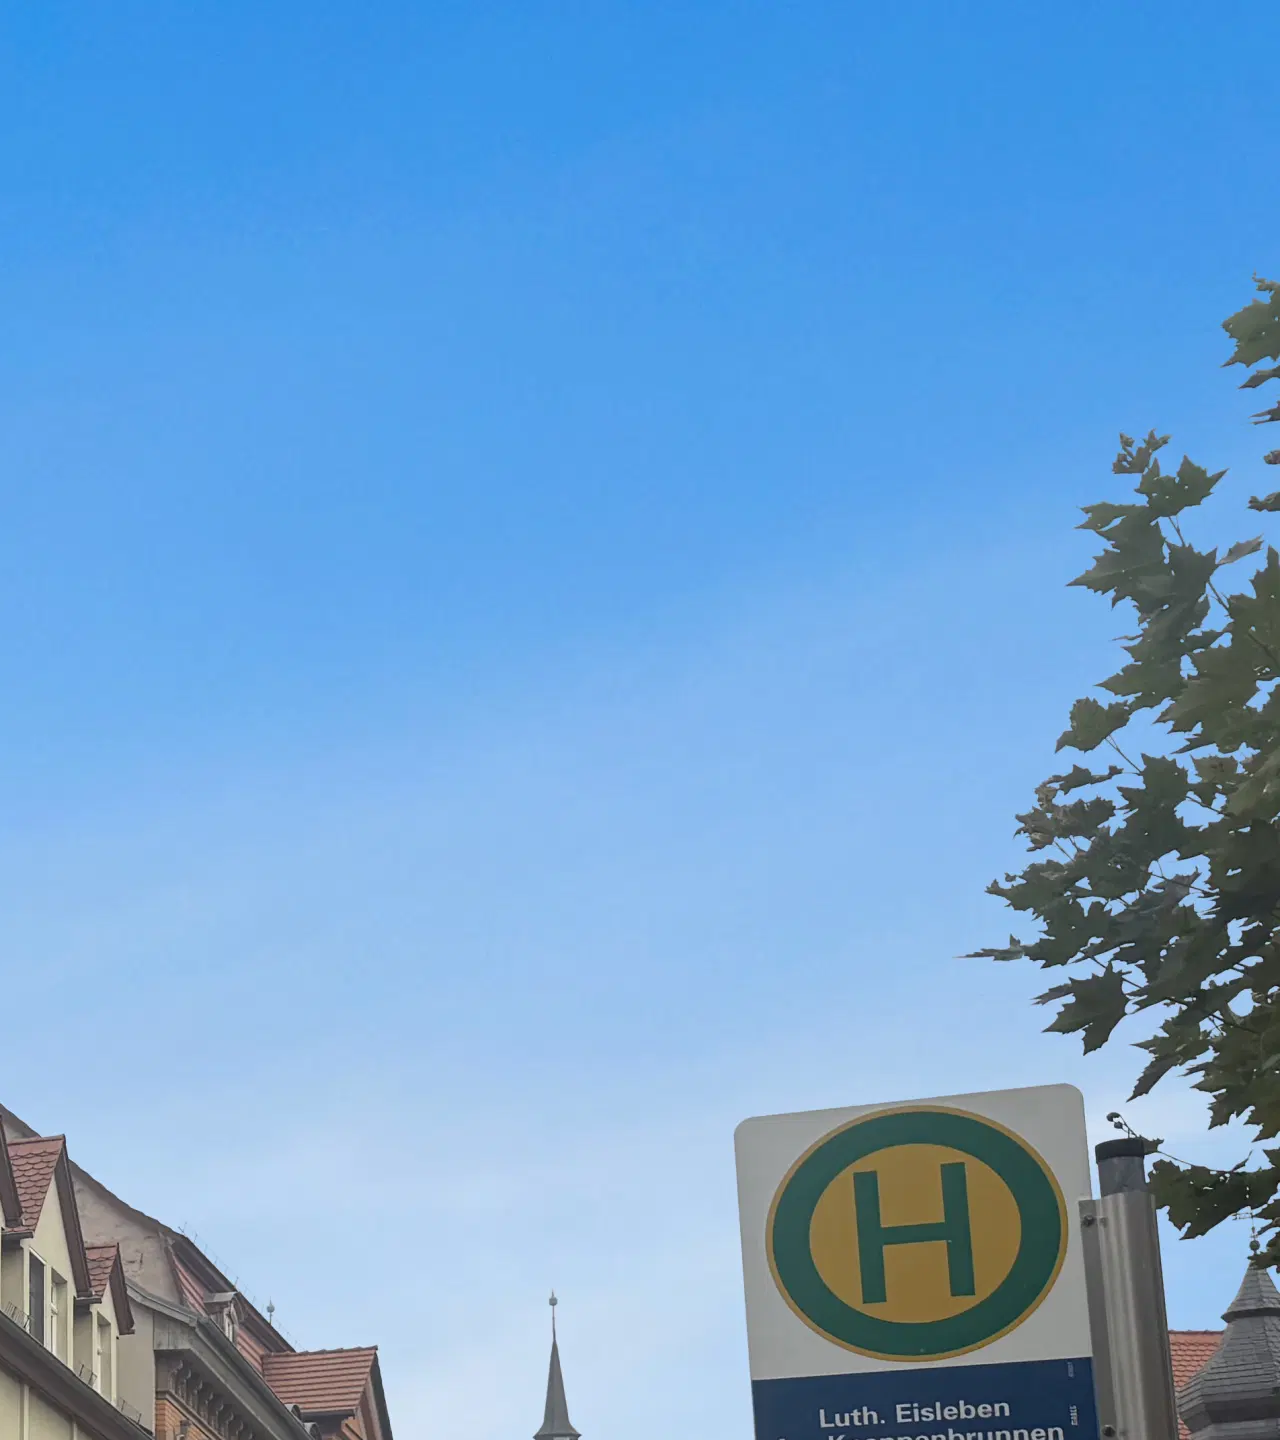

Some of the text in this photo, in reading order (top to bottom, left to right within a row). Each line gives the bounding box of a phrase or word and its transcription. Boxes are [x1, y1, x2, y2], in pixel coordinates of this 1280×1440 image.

[852, 1161, 976, 1305] H
[819, 1400, 1011, 1429] Luth. Eisleben
